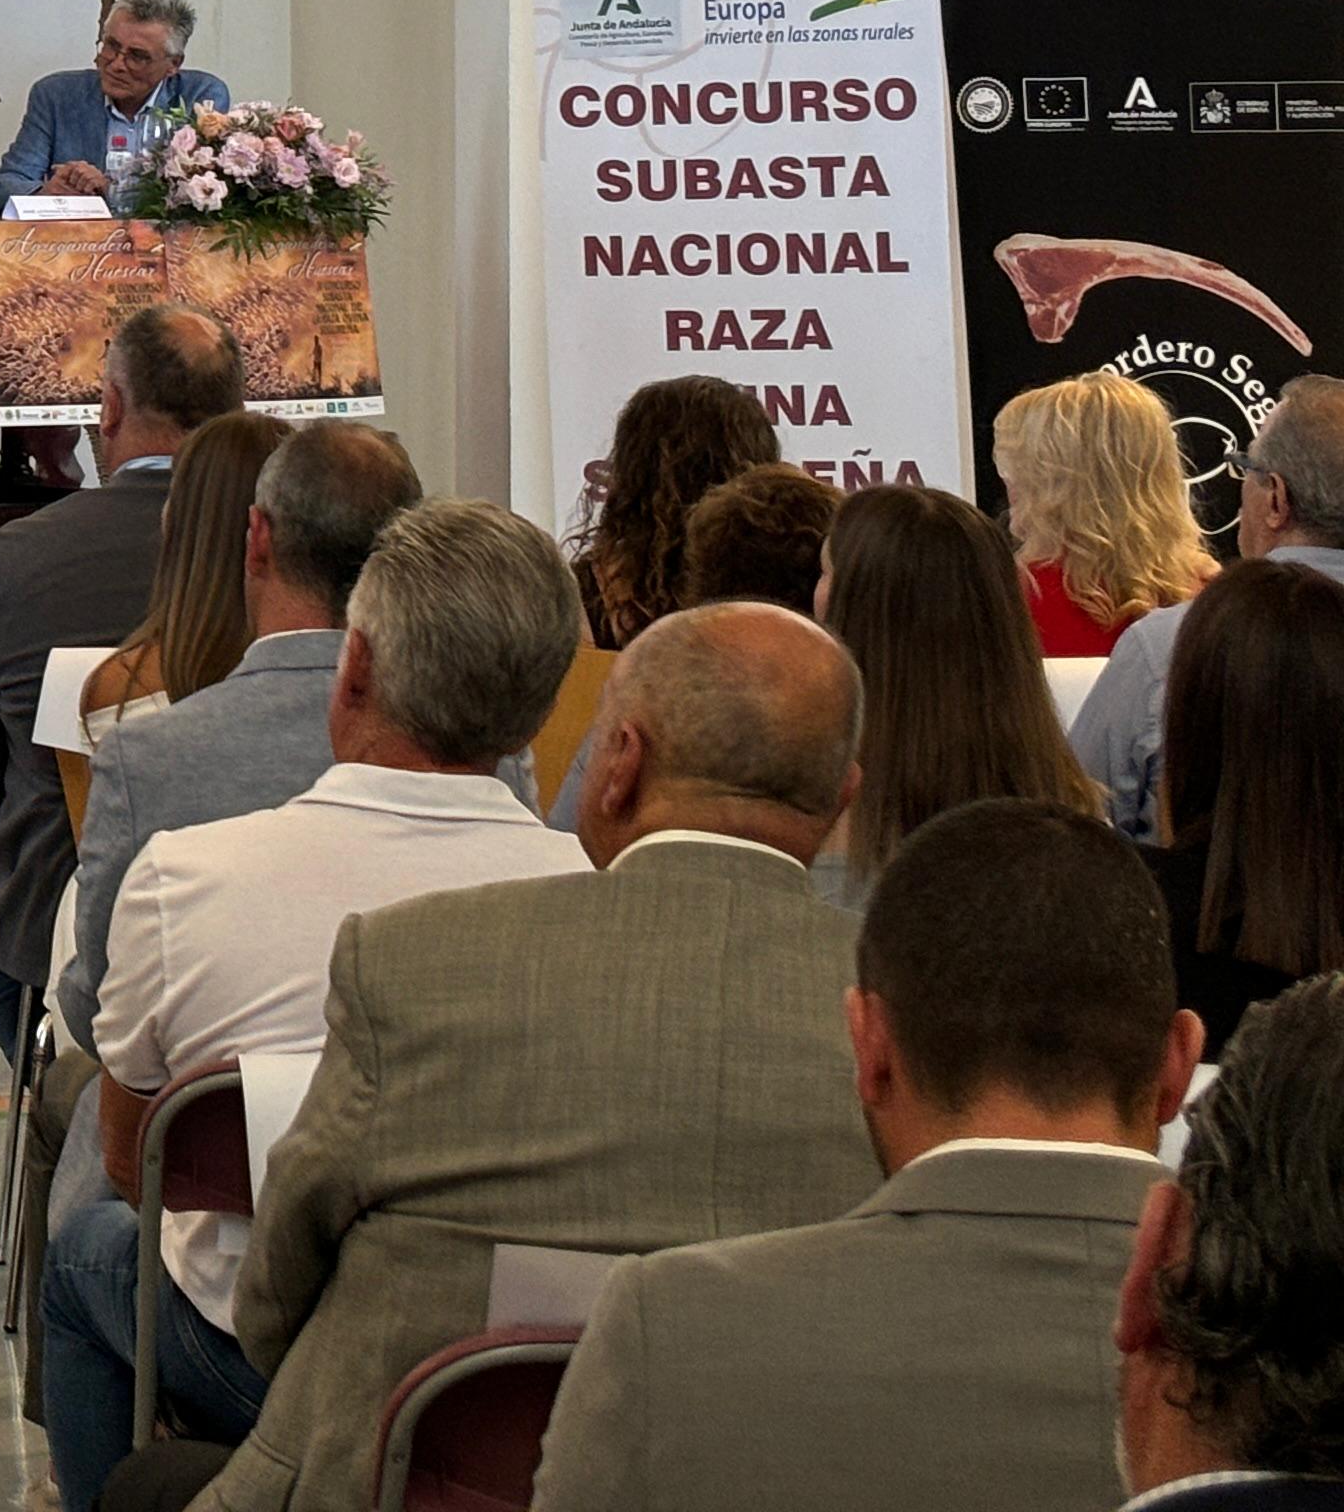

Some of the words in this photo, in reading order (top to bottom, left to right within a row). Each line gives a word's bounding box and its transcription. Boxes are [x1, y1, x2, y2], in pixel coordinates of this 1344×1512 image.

[570, 21, 601, 32] Junta
[603, 21, 616, 30] de
[619, 16, 672, 29] Andalucía
[704, 27, 762, 45] invierte
[766, 31, 784, 44] en
[788, 25, 809, 42] las
[812, 26, 858, 42] zonas
[862, 22, 915, 41] rurales
[559, 77, 918, 128] CONCURSO
[596, 155, 891, 202] SUBASTA
[583, 232, 910, 277] NACIONAL
[665, 308, 833, 351] RAZA
[1099, 333, 1216, 378] ordero
